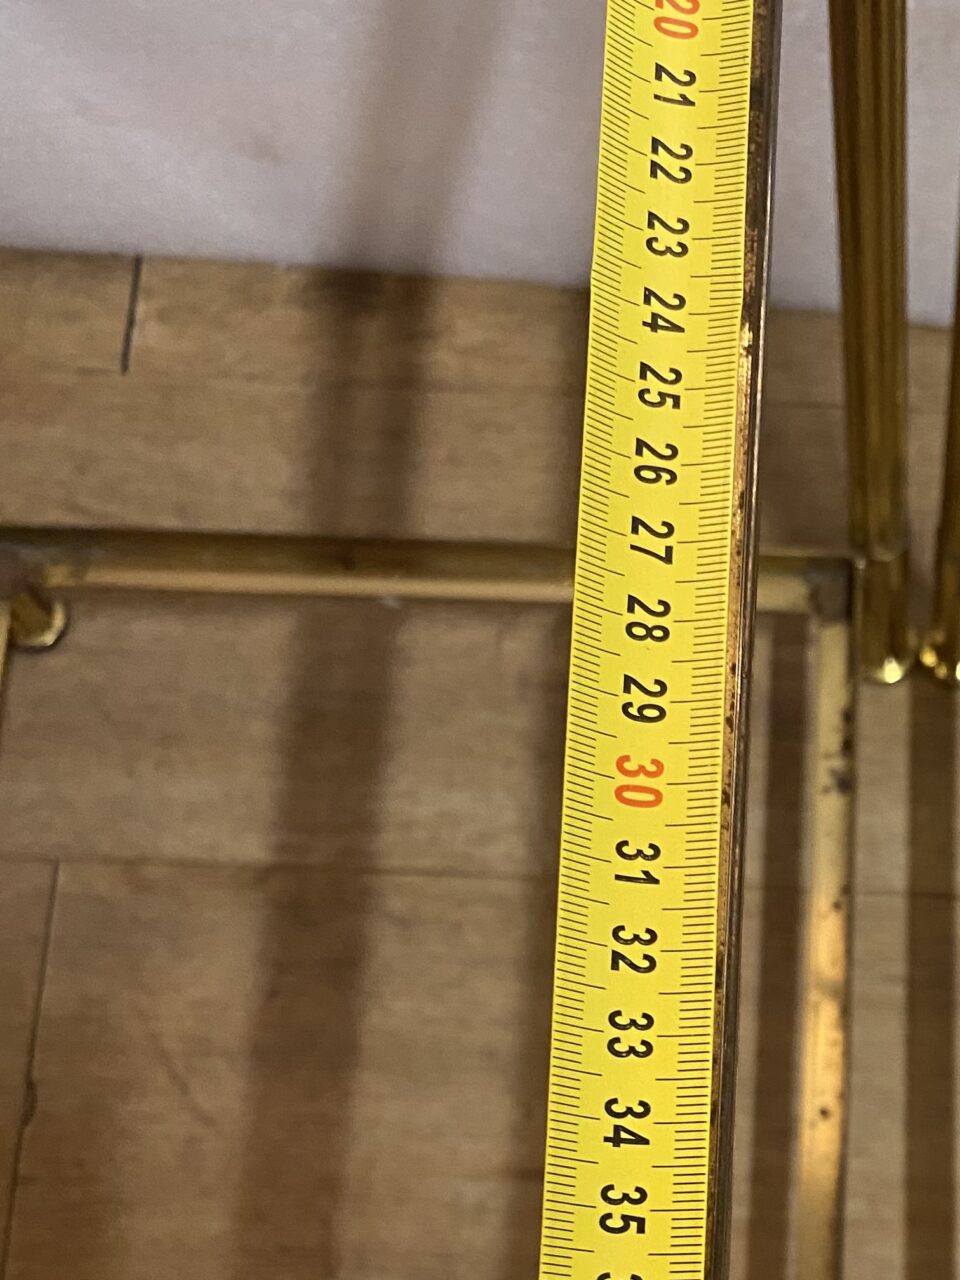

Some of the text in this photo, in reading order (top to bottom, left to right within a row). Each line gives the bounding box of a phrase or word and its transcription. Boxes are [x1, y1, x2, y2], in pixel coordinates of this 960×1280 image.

[654, 62, 697, 106] 21
[650, 136, 693, 183] 22
[645, 210, 690, 258] 23
[642, 286, 686, 333] 24
[637, 361, 683, 409] 25
[633, 437, 679, 485] 26
[630, 515, 675, 565] 27
[625, 594, 671, 643] 28
[621, 673, 668, 723] 29
[614, 754, 664, 810] 30
[614, 840, 661, 885] 31
[610, 925, 658, 974] 32
[607, 1010, 655, 1059] 33
[603, 1097, 651, 1148] 34
[598, 1184, 648, 1235] 35
